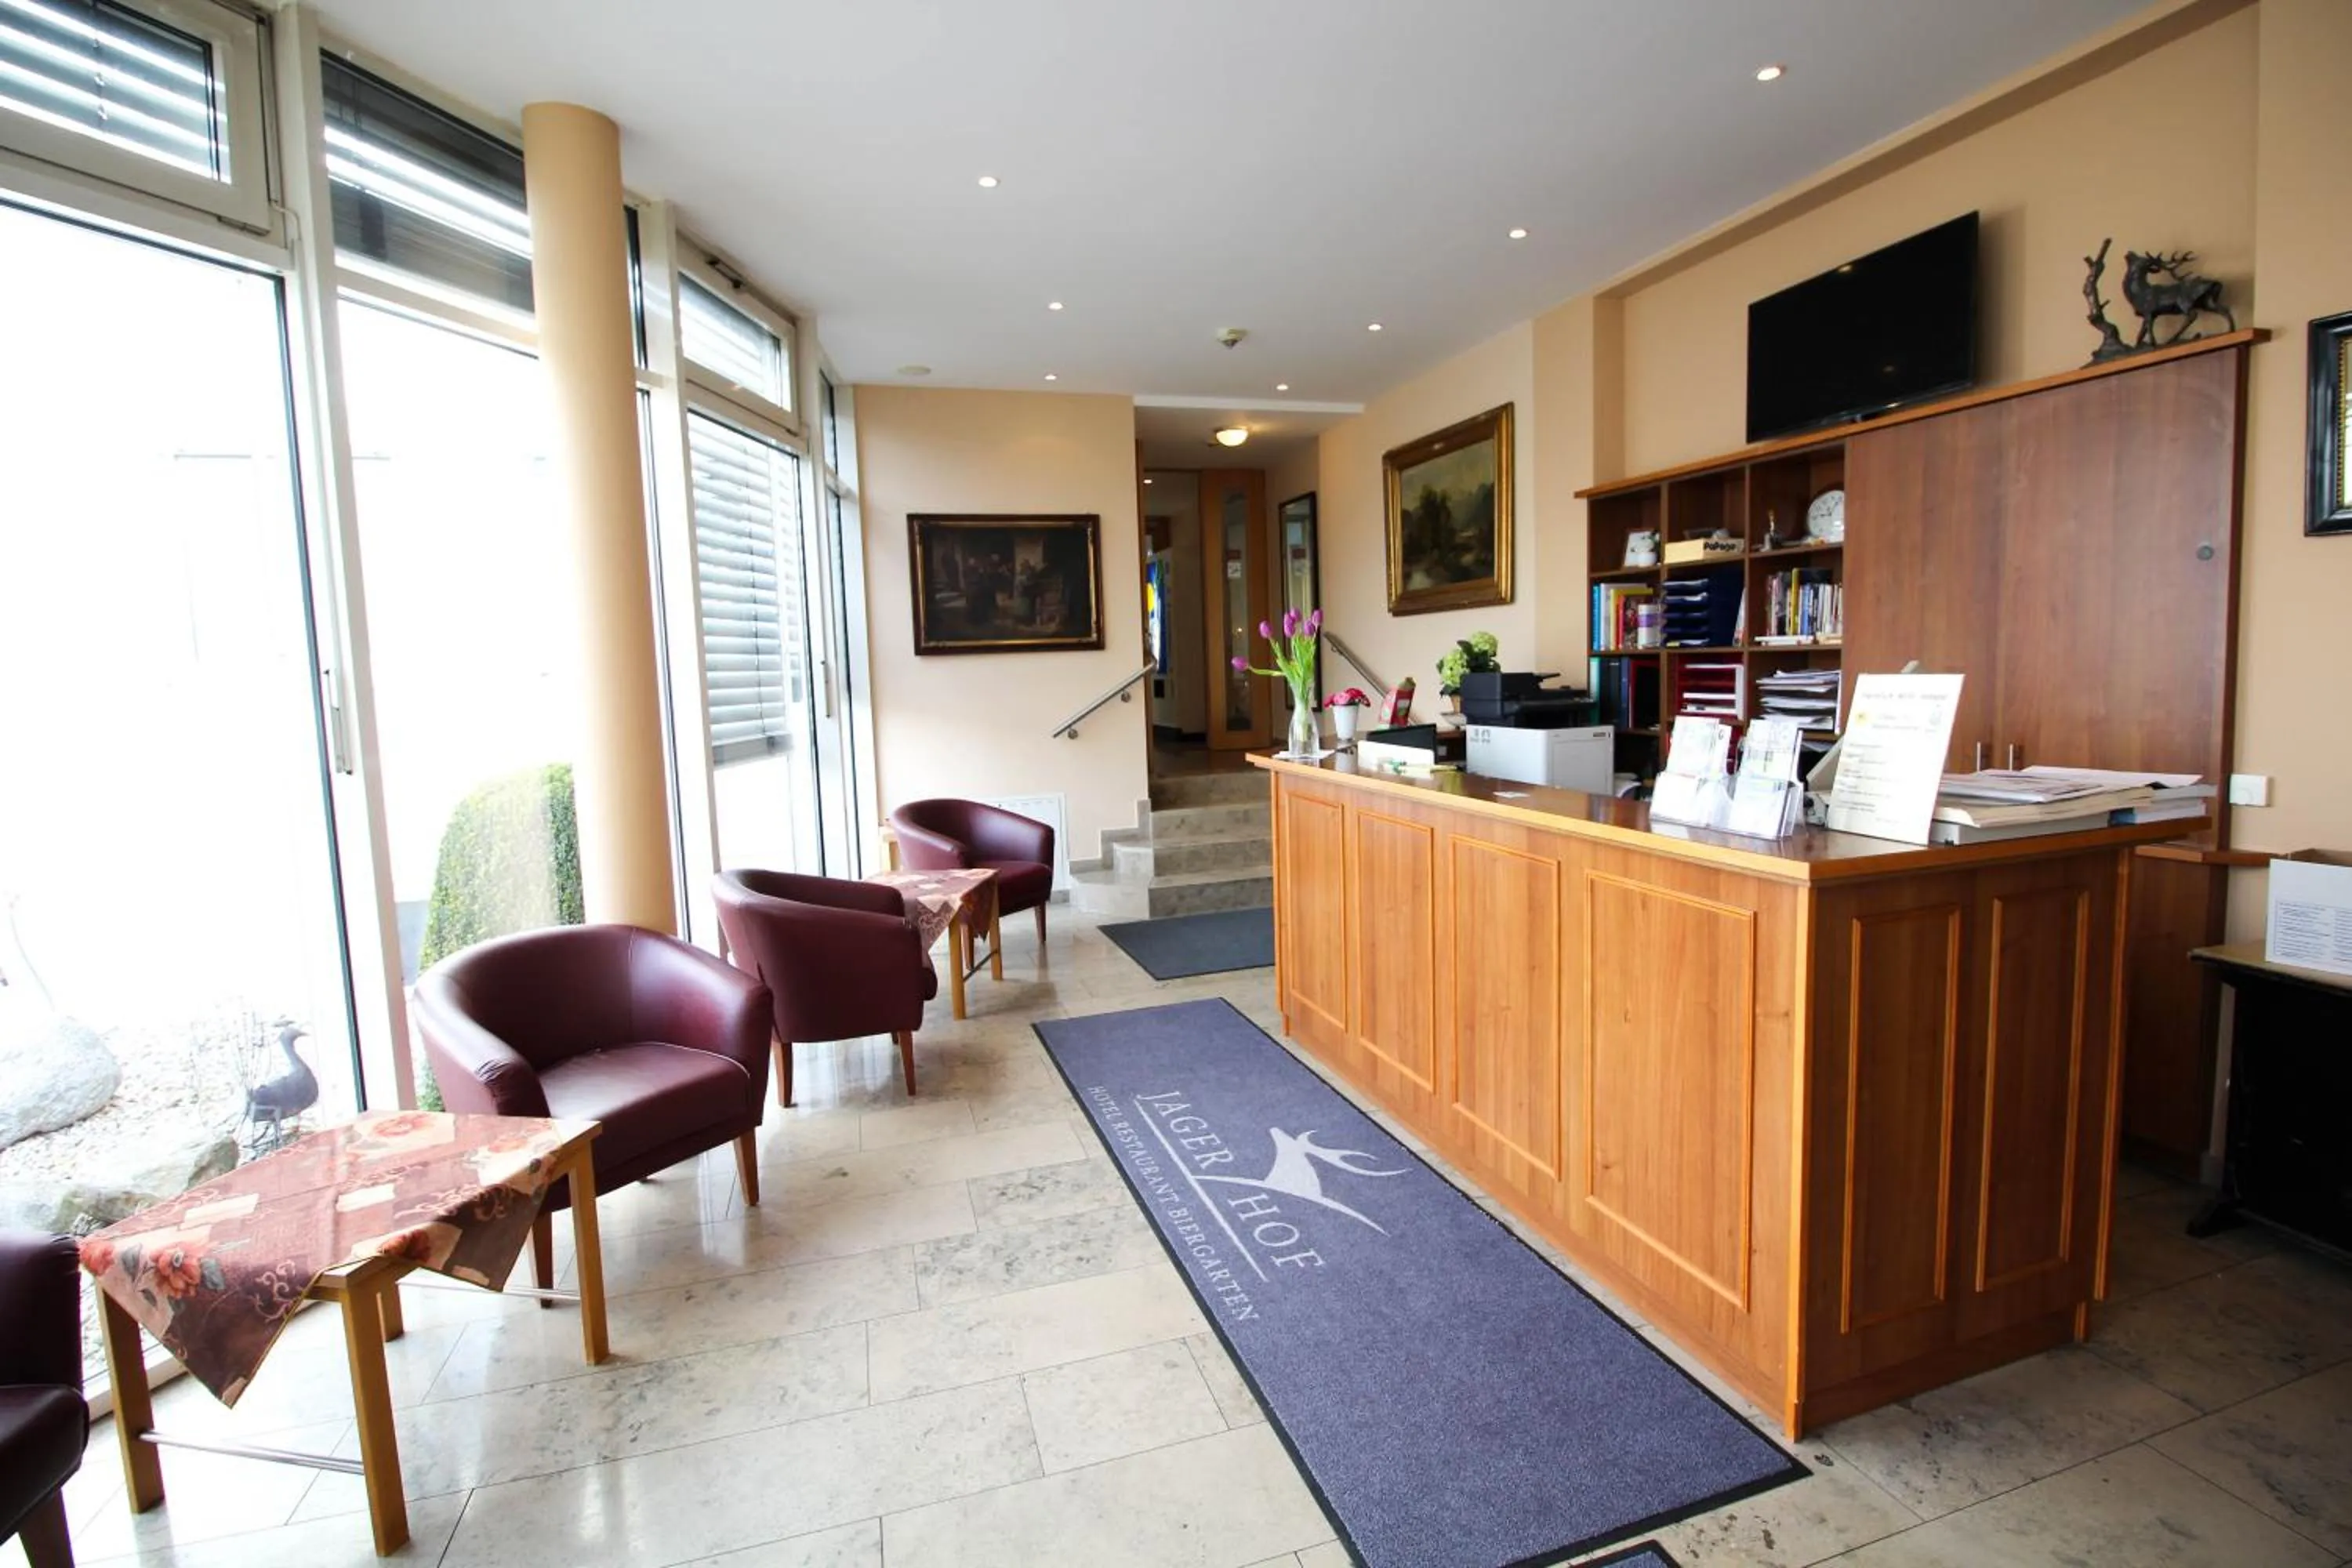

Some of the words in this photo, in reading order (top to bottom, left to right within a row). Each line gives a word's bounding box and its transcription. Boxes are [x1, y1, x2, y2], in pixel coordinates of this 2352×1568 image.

[1087, 1086, 1123, 1120] HOTEL
[1111, 1121, 1179, 1203] RESTAURANT
[1167, 1207, 1260, 1320] BIERGARTEN
[1227, 1192, 1327, 1269] HOF
